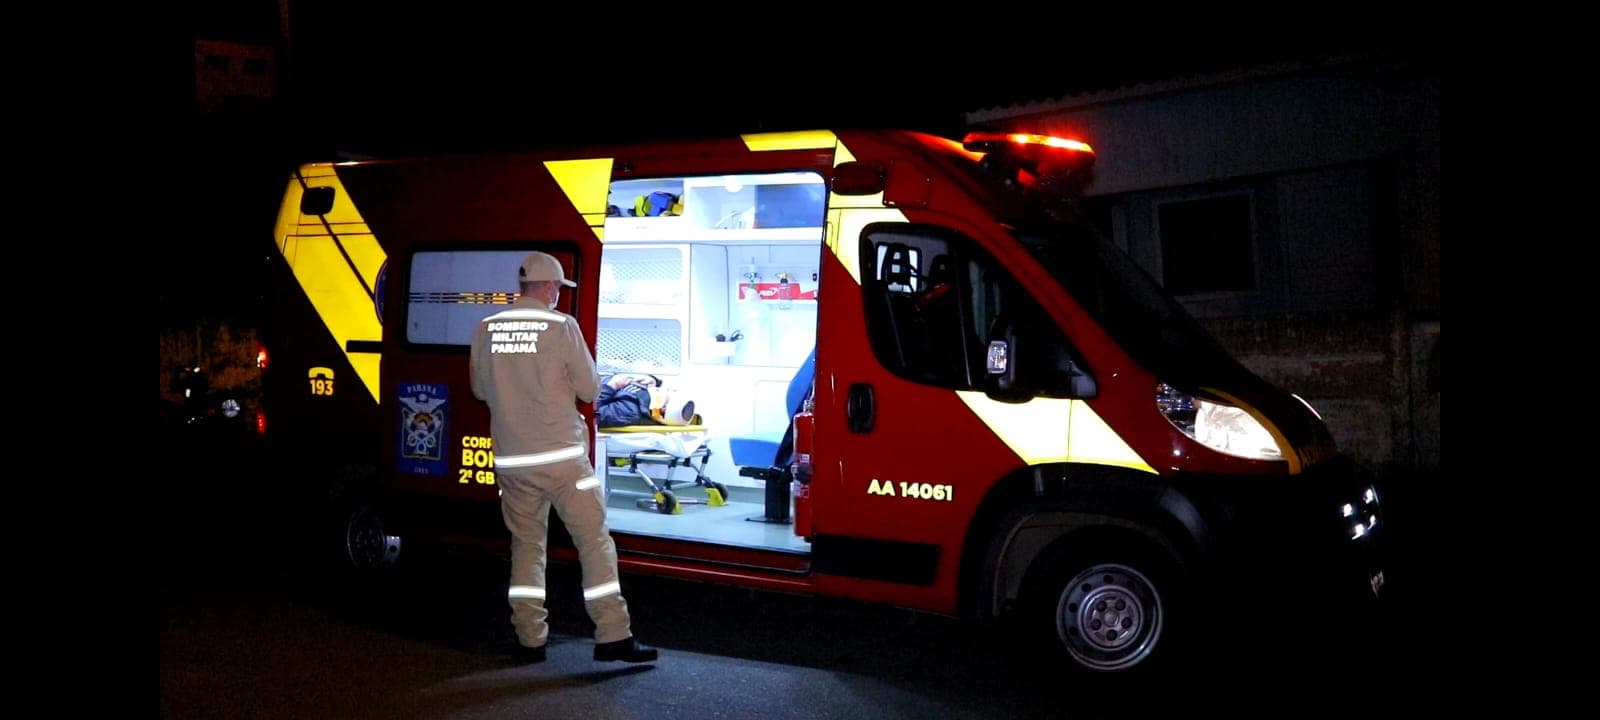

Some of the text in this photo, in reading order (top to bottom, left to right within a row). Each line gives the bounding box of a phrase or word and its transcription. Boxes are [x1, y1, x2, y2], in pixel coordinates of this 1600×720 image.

[487, 321, 549, 332] BOMBEIRO
[491, 332, 539, 343] MILITAR
[490, 341, 538, 354] PARANÁ
[309, 379, 334, 396] 193
[475, 470, 496, 485] GB
[867, 478, 954, 502] AA 14061
